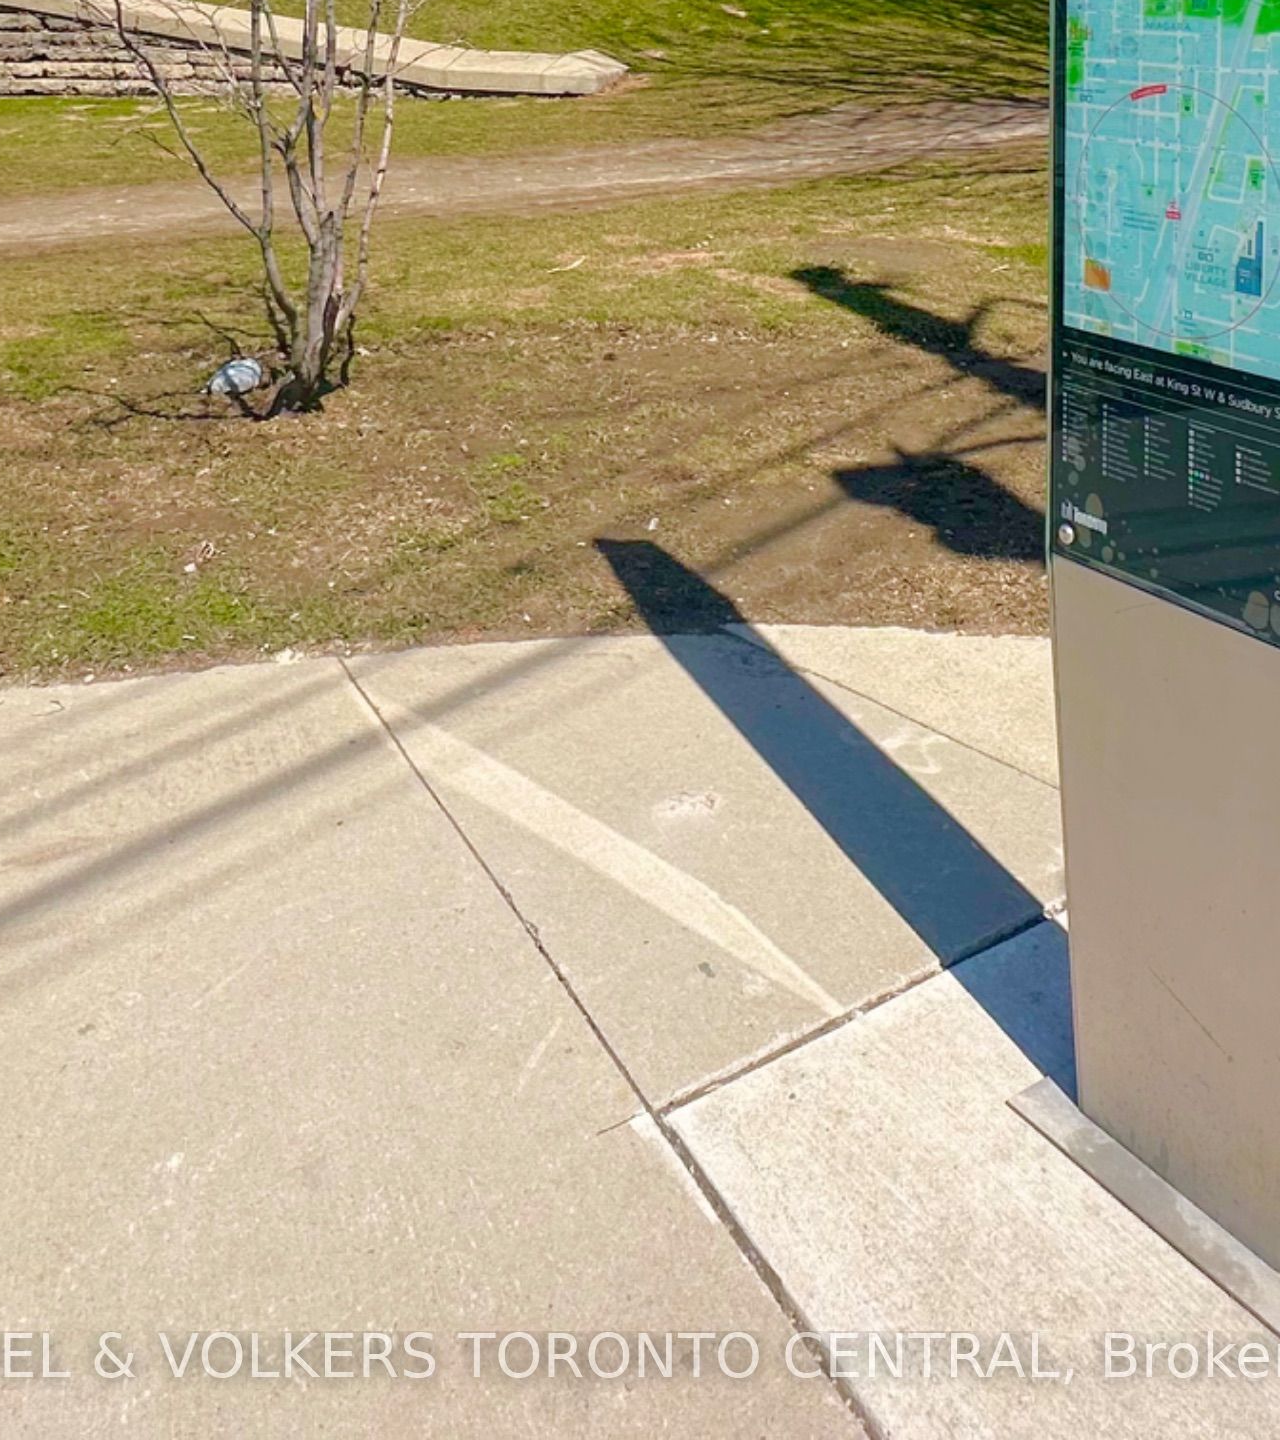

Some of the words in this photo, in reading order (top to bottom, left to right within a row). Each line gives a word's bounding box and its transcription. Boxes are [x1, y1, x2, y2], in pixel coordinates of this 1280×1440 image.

[1071, 351, 1088, 365] You
[1089, 358, 1103, 370] are
[1104, 360, 1132, 379] facing
[1133, 368, 1153, 383] East
[1155, 376, 1165, 388] at
[1167, 377, 1189, 395] King
[1191, 384, 1201, 397] St
[1203, 388, 1216, 400] W
[1217, 392, 1225, 404] &
[1228, 394, 1271, 418] Sudbury
